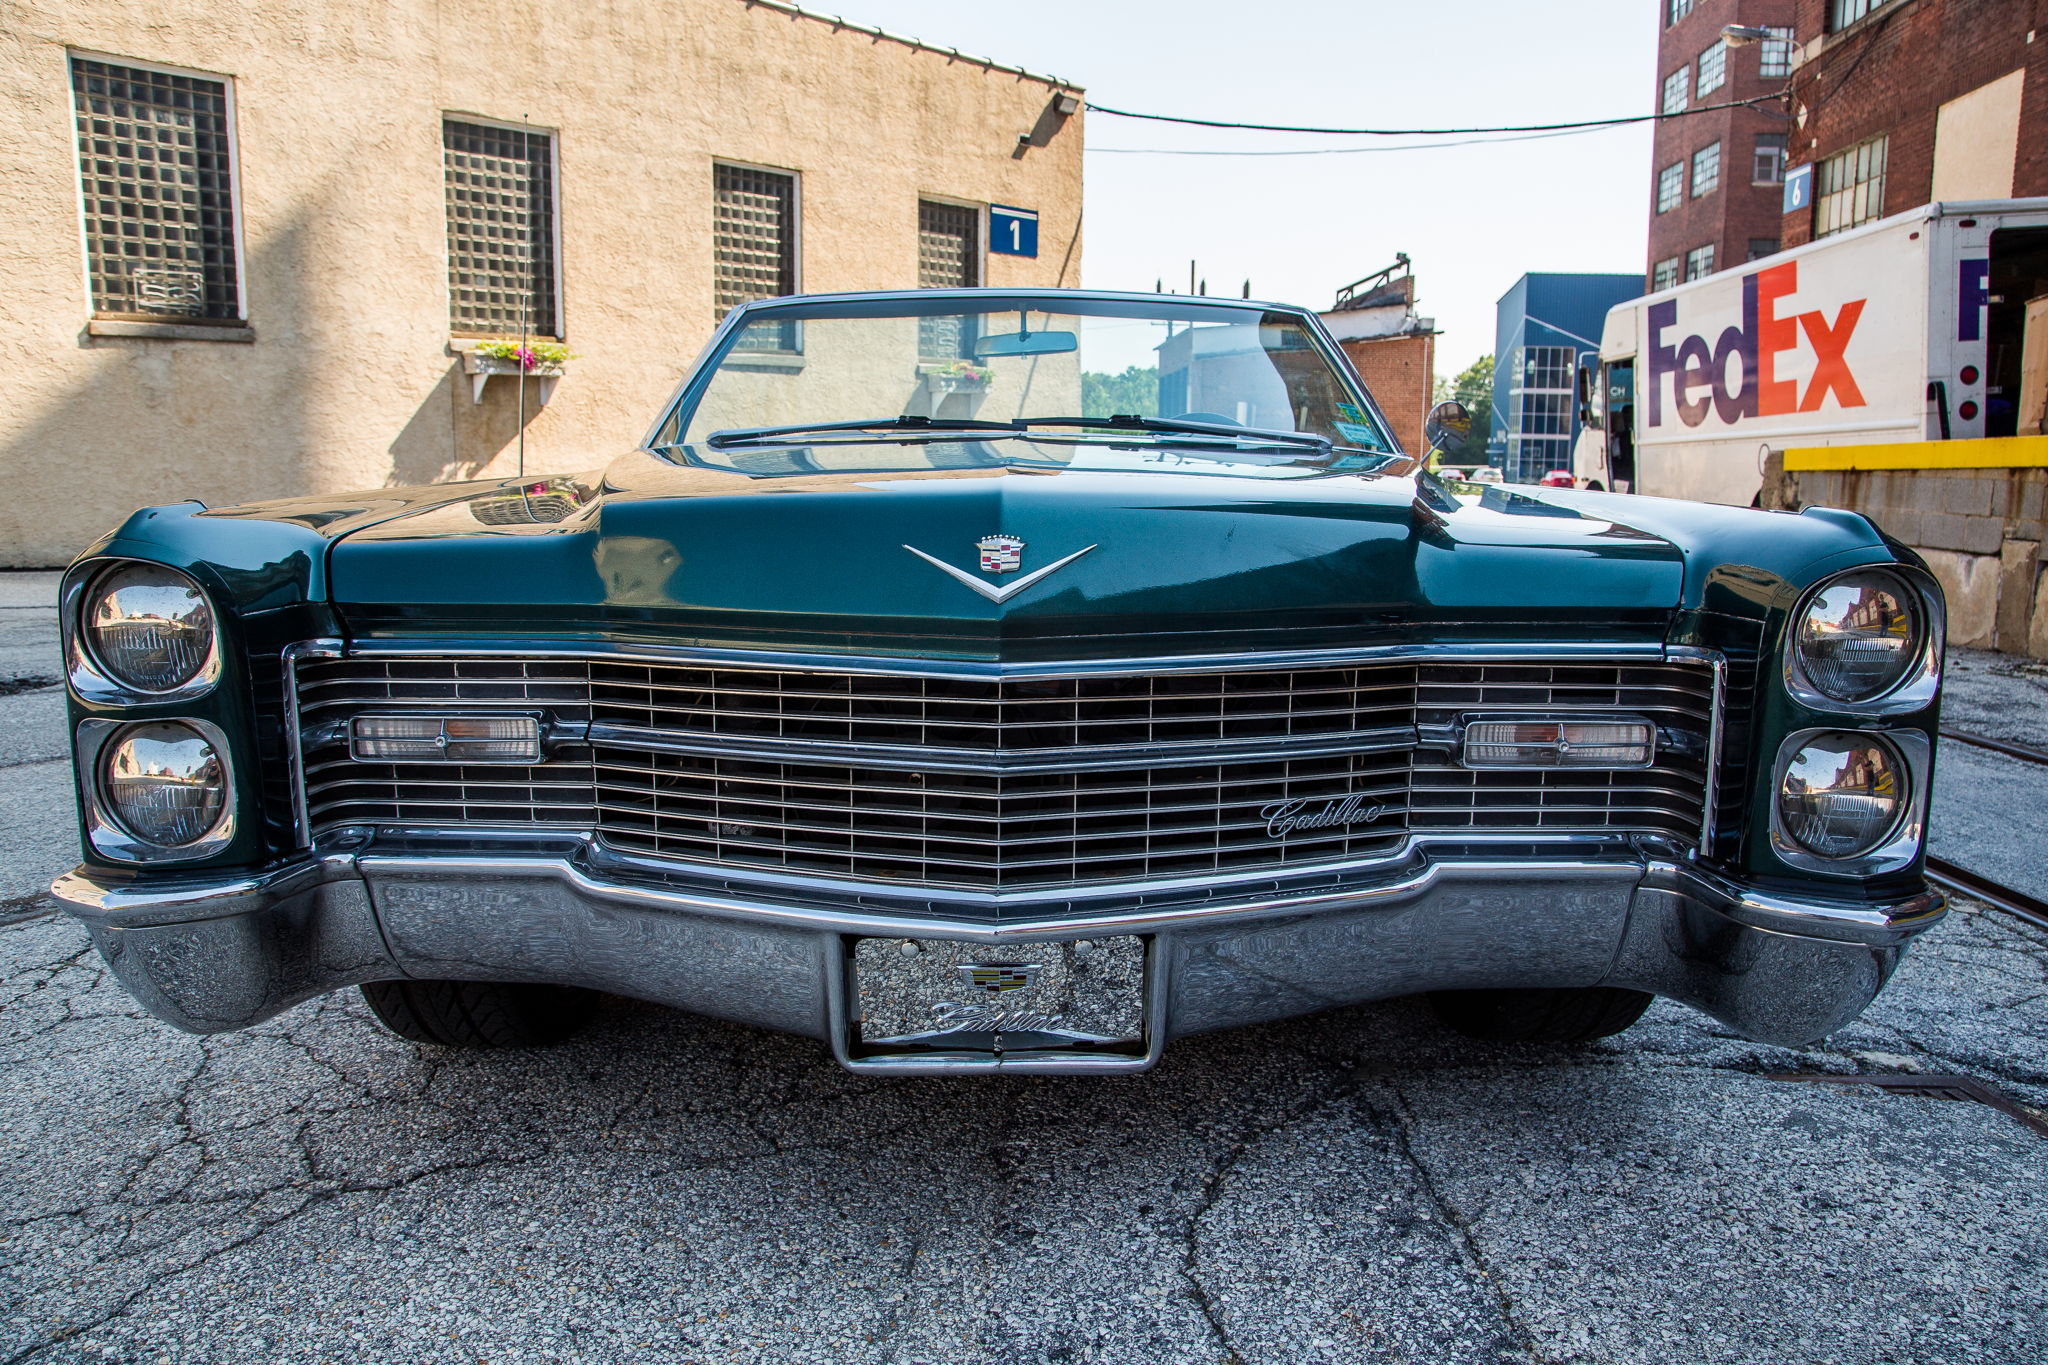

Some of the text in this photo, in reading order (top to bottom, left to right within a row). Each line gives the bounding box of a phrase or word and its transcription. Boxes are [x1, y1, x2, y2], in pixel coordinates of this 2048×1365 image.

[1792, 177, 1801, 206] 6
[1009, 219, 1020, 251] 1
[1648, 260, 1867, 428] FedEx
[1260, 795, 1385, 838] Cadillac
[932, 1001, 1062, 1032] Cadillac
